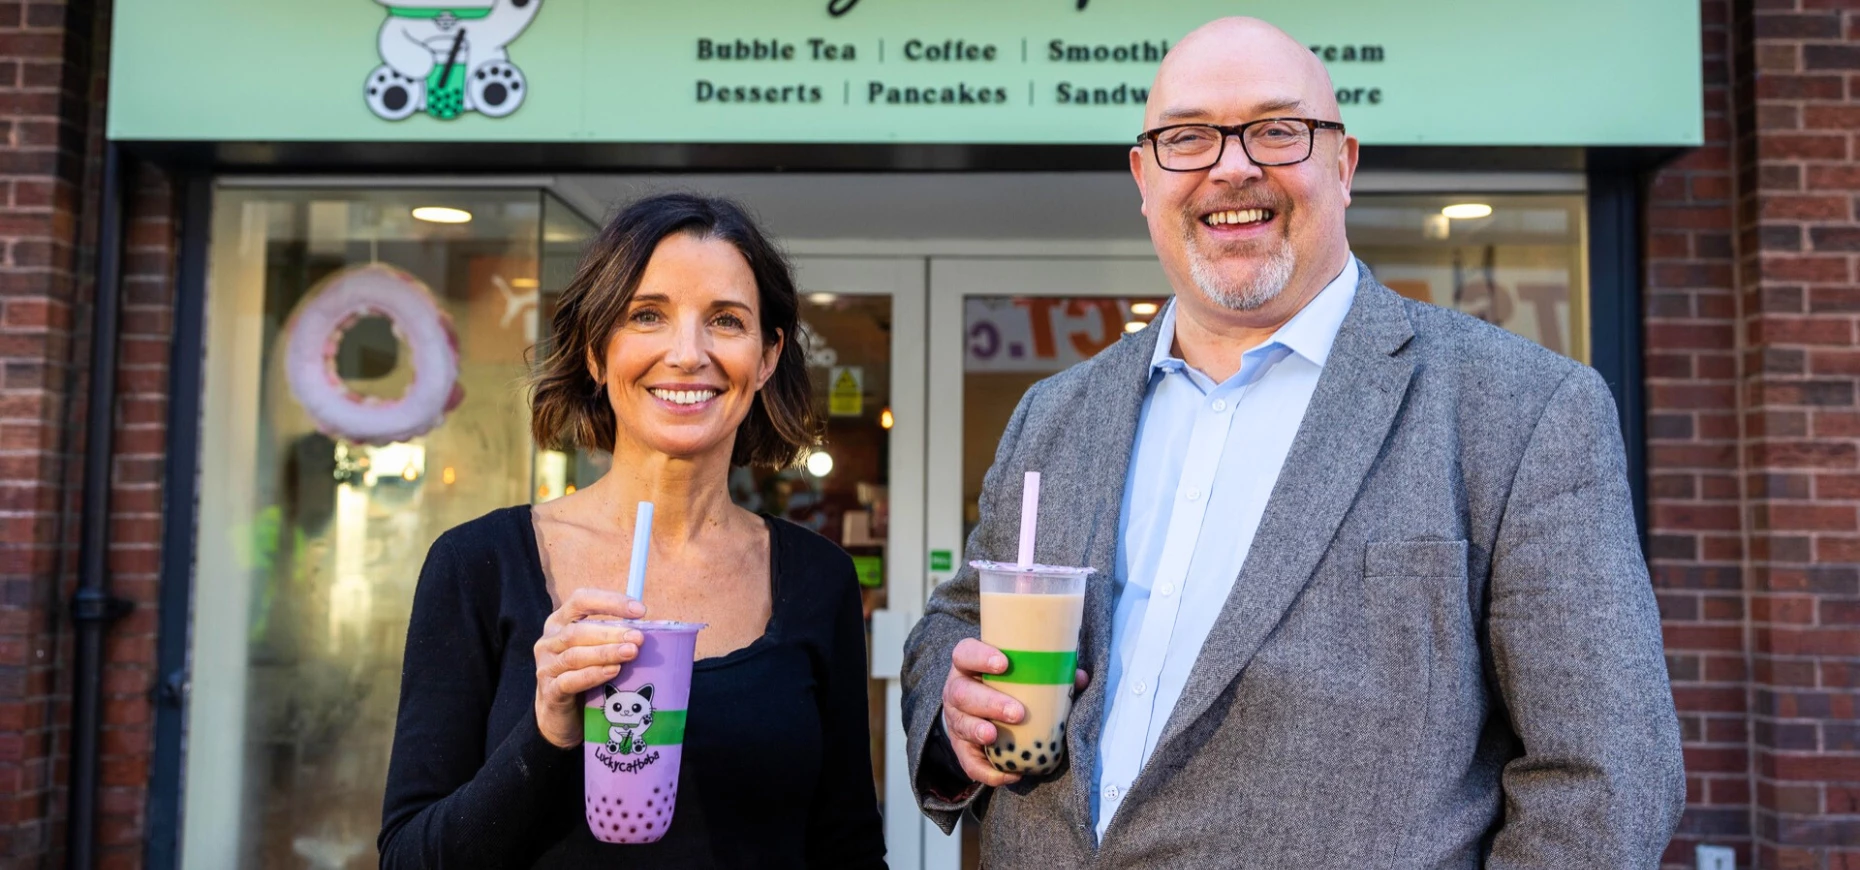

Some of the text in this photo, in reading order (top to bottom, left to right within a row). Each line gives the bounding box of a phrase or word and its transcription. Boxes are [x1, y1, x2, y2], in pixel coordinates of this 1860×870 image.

[696, 38, 1385, 62] Bubble Tea Coffee Smoothi ream
[695, 81, 1382, 105] Desserts Pancakes Sandw ore
